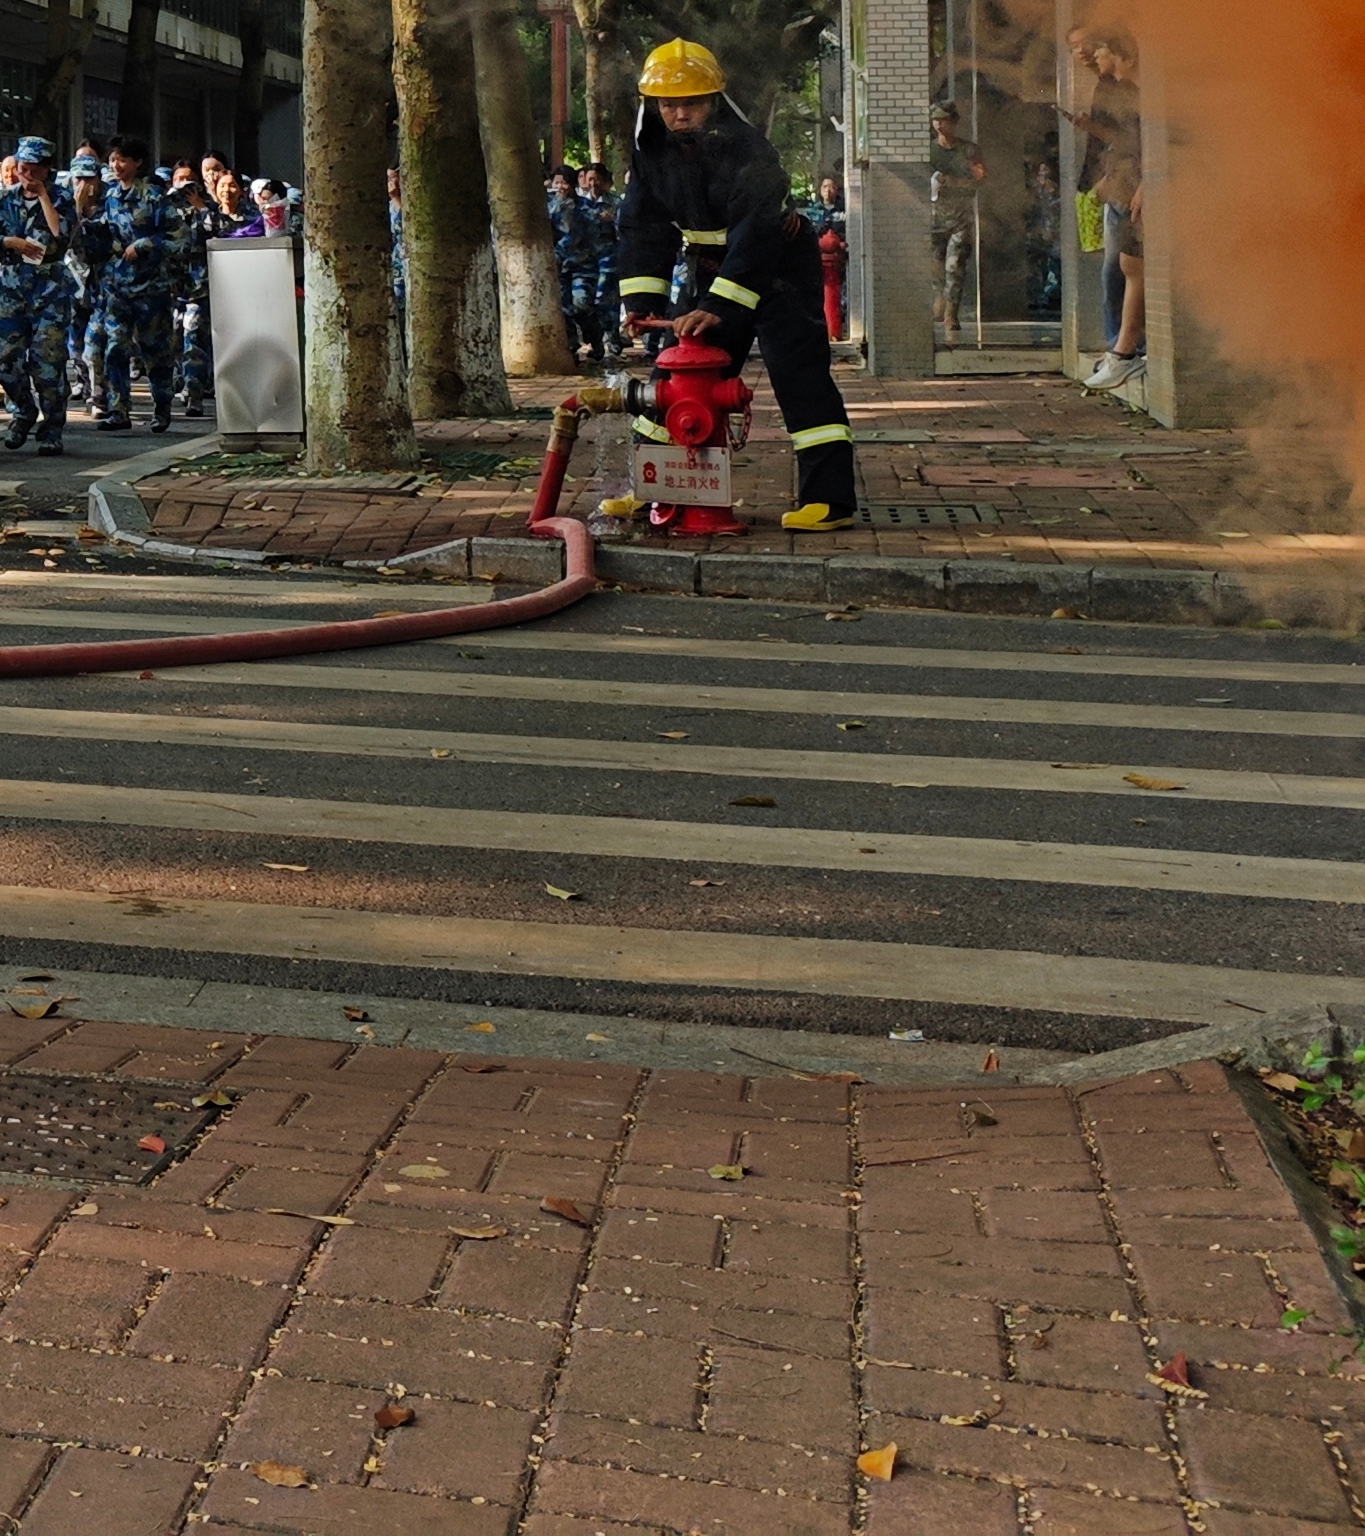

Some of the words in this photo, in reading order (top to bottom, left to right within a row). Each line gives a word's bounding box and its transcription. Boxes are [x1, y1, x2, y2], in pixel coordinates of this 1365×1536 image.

[664, 474, 720, 490] 地上消火栓
